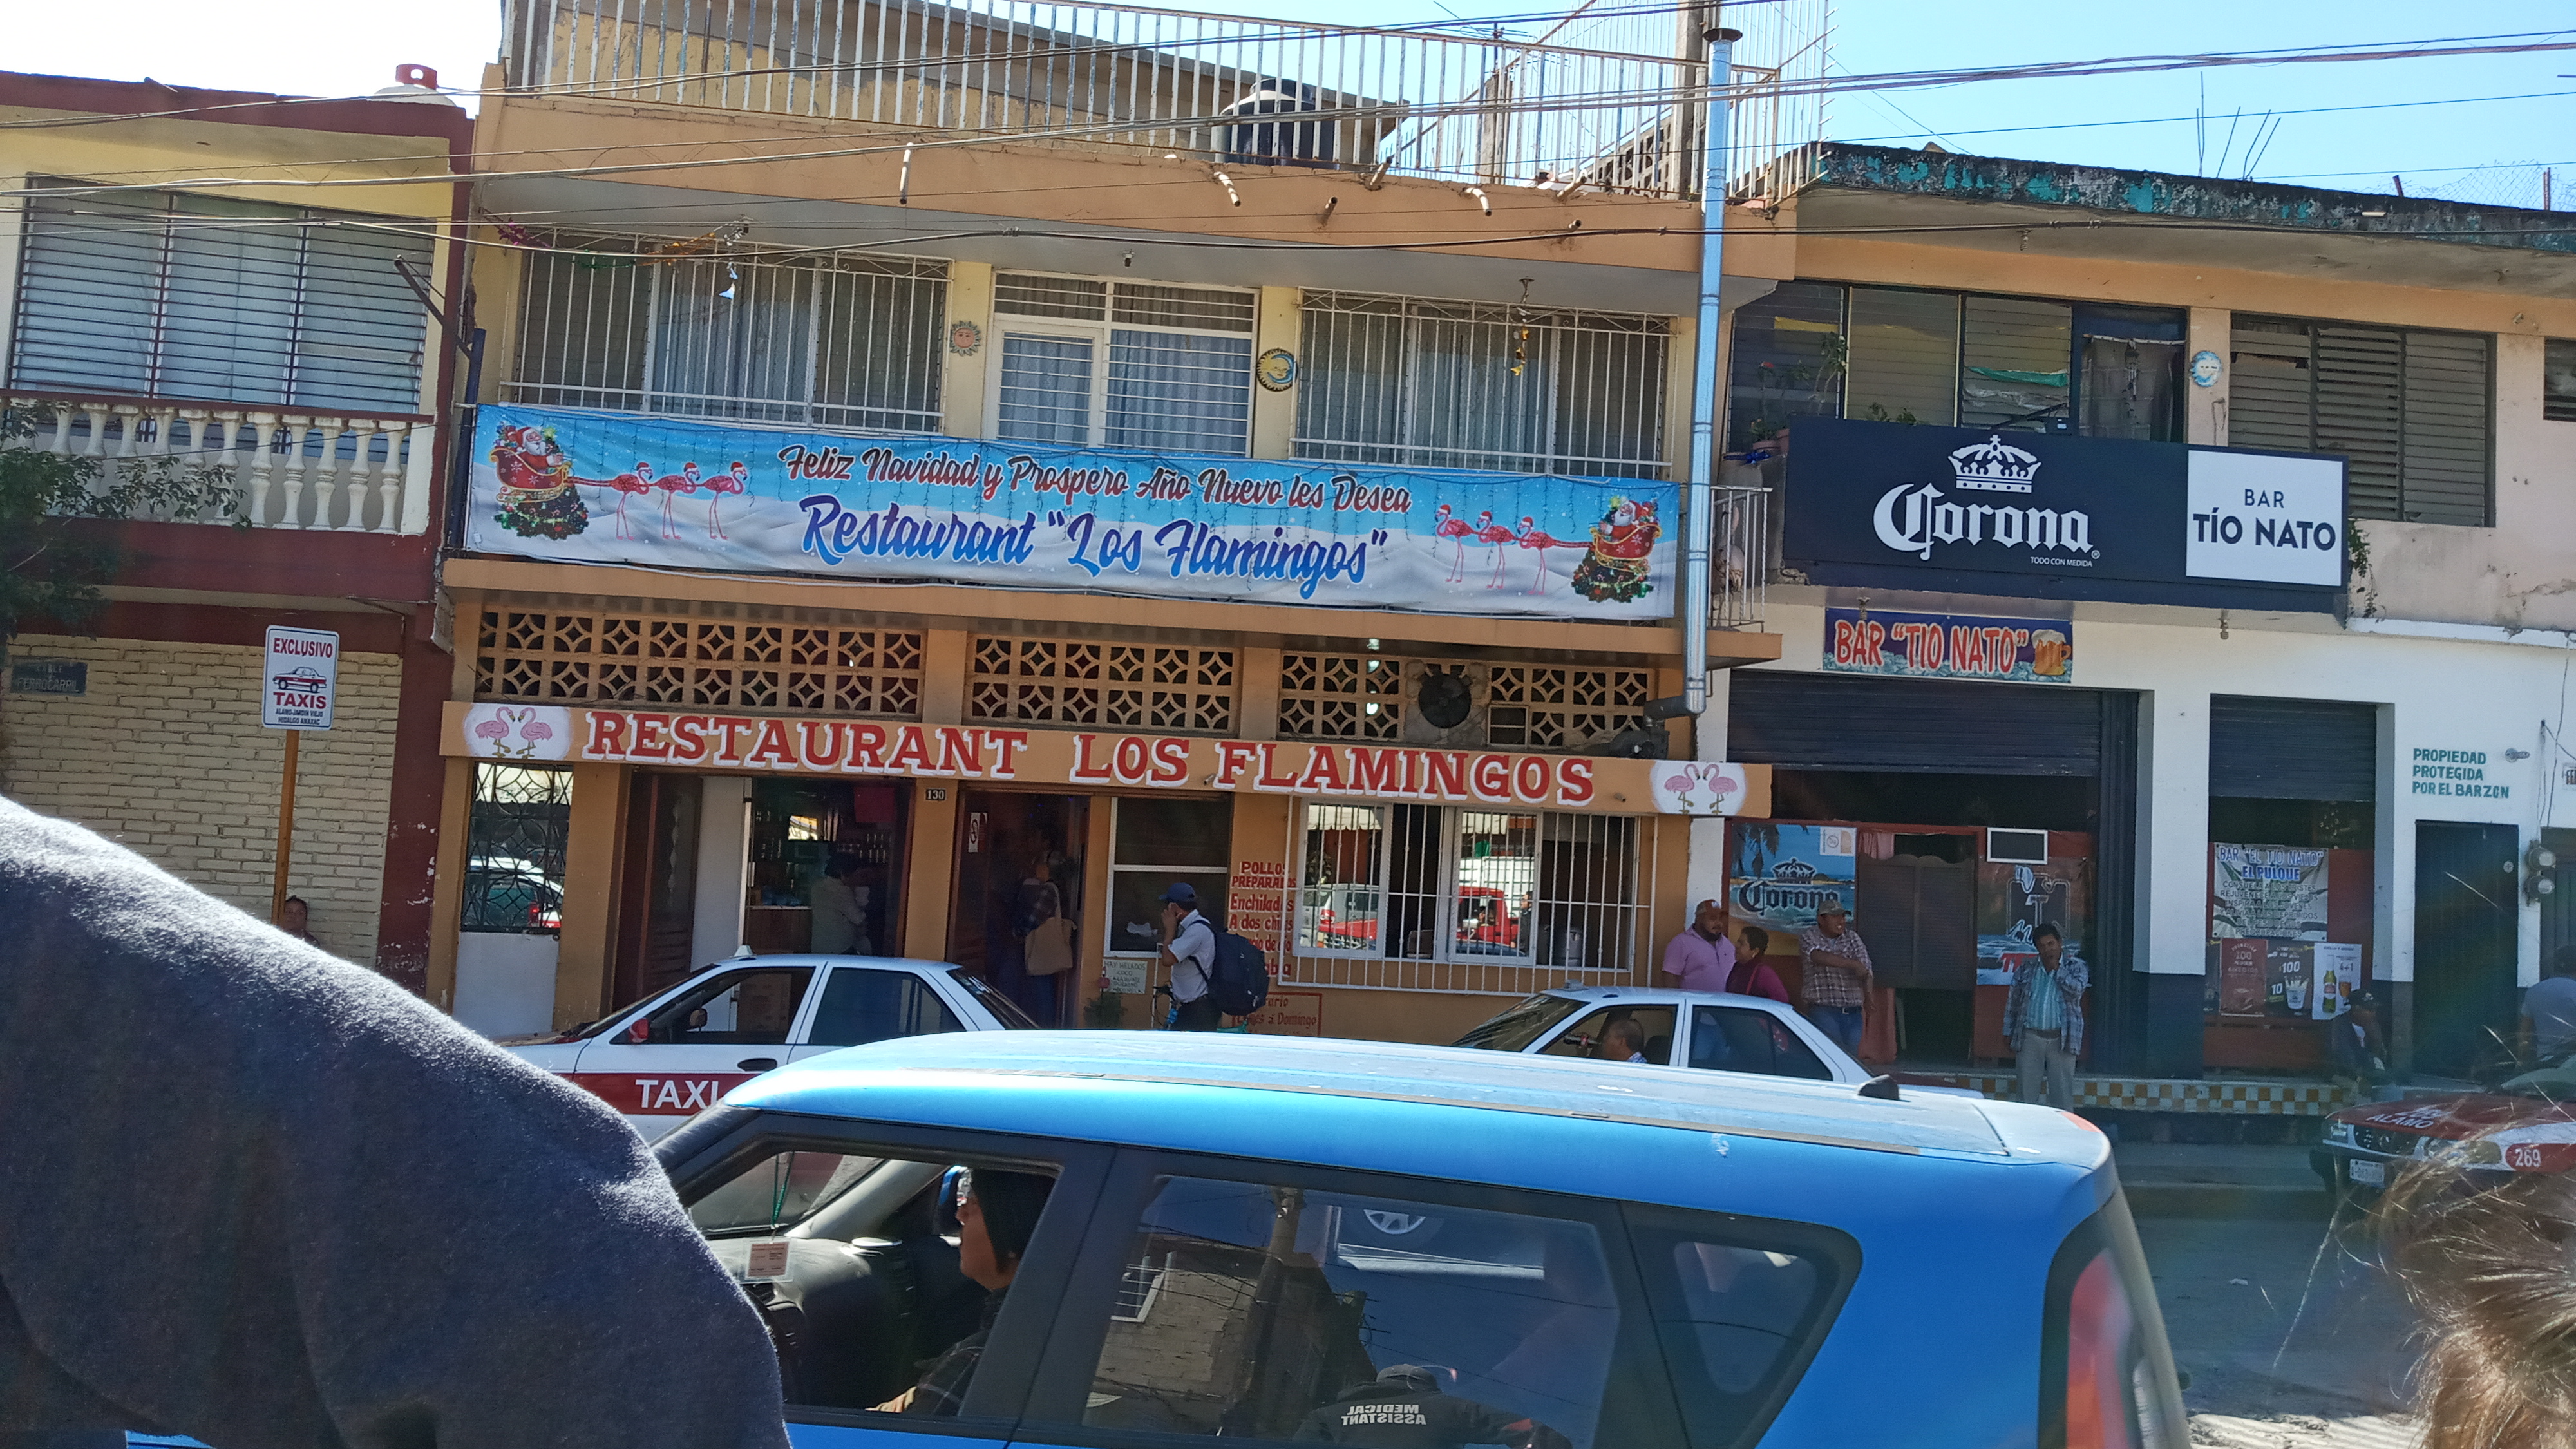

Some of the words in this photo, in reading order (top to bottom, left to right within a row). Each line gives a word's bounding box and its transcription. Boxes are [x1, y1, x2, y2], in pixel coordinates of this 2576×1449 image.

[779, 444, 855, 481] Feliz
[862, 448, 980, 488] Navidad
[982, 461, 1003, 501] y
[1007, 455, 1128, 506] Prospero
[1135, 466, 1191, 502] Año
[1198, 468, 1283, 506] Nuevo
[1288, 474, 1324, 509] les
[1331, 475, 1413, 513] Desea
[2244, 488, 2284, 508] BAR
[1873, 482, 2094, 561] Corona
[2193, 507, 2243, 545] TÍO
[2255, 517, 2336, 551] NATO
[799, 495, 1037, 565] Restaurant
[1048, 511, 1143, 578] "Los
[1155, 519, 1388, 600] Flamingos"
[273, 638, 333, 658] EXCLUSIVO
[1835, 619, 1886, 667] BAR
[1891, 622, 1944, 670] "TIO
[1949, 625, 2029, 674] NATO"
[273, 692, 327, 709] TAXIS
[582, 711, 1028, 779] RESTAURANT
[1068, 734, 1189, 788] LOS
[1213, 741, 1595, 806] FLAMINGOS
[2413, 748, 2487, 764] PROPIEDAD
[2412, 764, 2484, 781] PROTEGIDA
[927, 790, 945, 799] 130
[2412, 781, 2436, 795] POR
[2438, 782, 2452, 796] EL
[2219, 848, 2239, 862] BAR
[2242, 866, 2254, 878] EL
[2257, 867, 2300, 880] PULQUE
[1229, 893, 1294, 913] Enchilads
[1228, 913, 1238, 931] A
[1240, 913, 1260, 932] dos
[1264, 934, 1276, 952] de
[2271, 983, 2284, 995] 10
[635, 1079, 719, 1109] TAXI
[2365, 1113, 2434, 1128] ALAMO
[2514, 1148, 2542, 1167] 269
